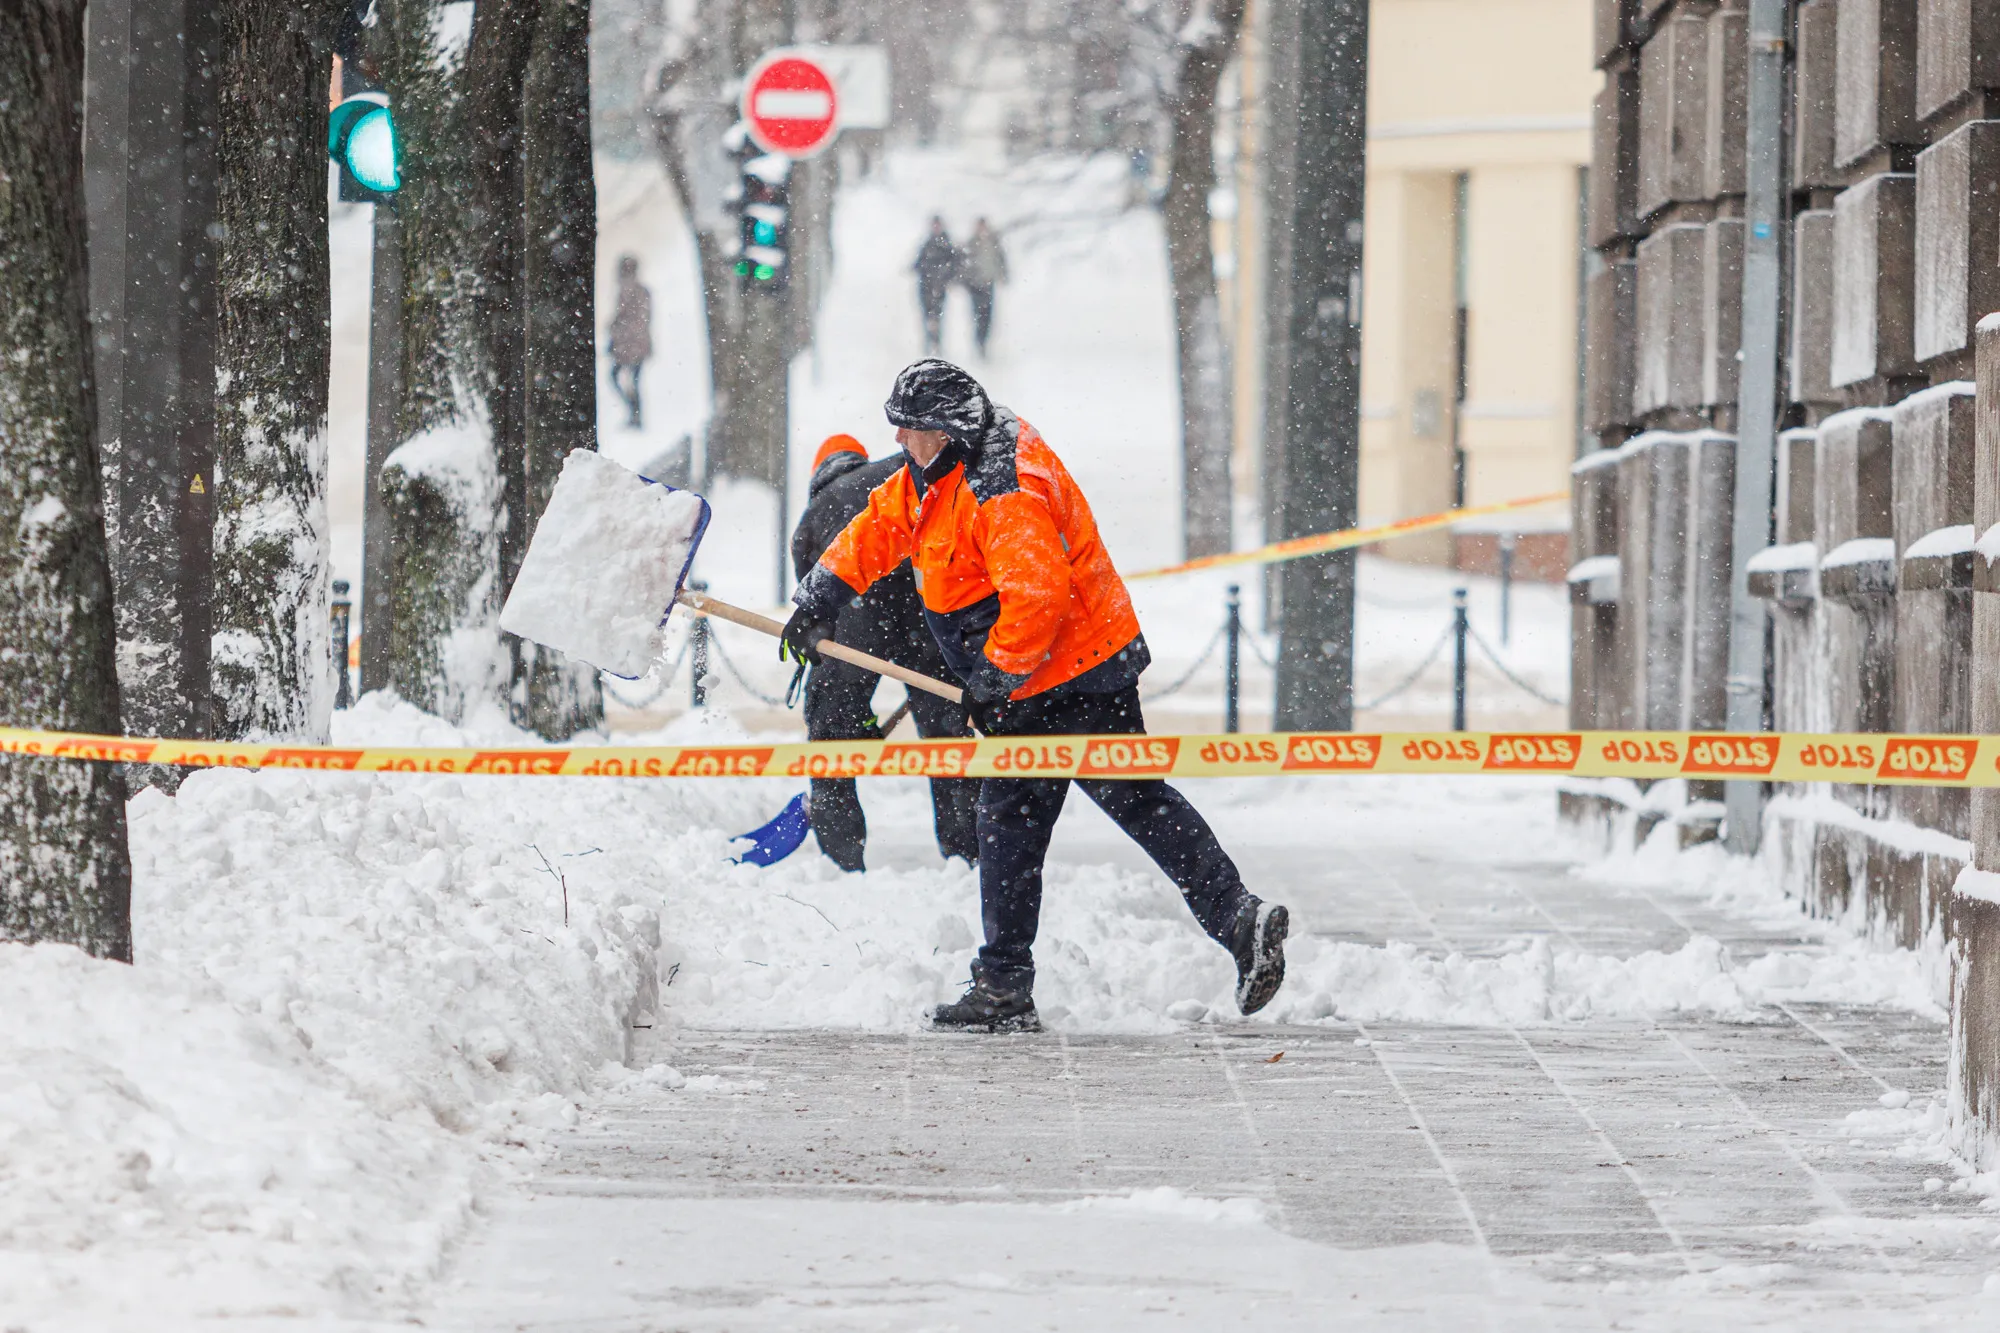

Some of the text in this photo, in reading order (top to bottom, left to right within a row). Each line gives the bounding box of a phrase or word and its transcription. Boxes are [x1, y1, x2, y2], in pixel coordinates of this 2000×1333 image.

[582, 758, 662, 776] STOP
[676, 756, 757, 776] STOP
[786, 754, 867, 777] STOP
[880, 749, 963, 776] STOP
[993, 746, 1073, 770] STOP
[1088, 741, 1171, 768] STOP
[1200, 740, 1279, 764] STOP
[1293, 738, 1374, 763] STOP
[1402, 739, 1480, 761] STOP
[1494, 738, 1573, 763] STOP
[1602, 740, 1679, 764] STOP
[1693, 741, 1771, 767] STOP
[1800, 744, 1875, 769] STOP
[1889, 745, 1967, 773] STOP
